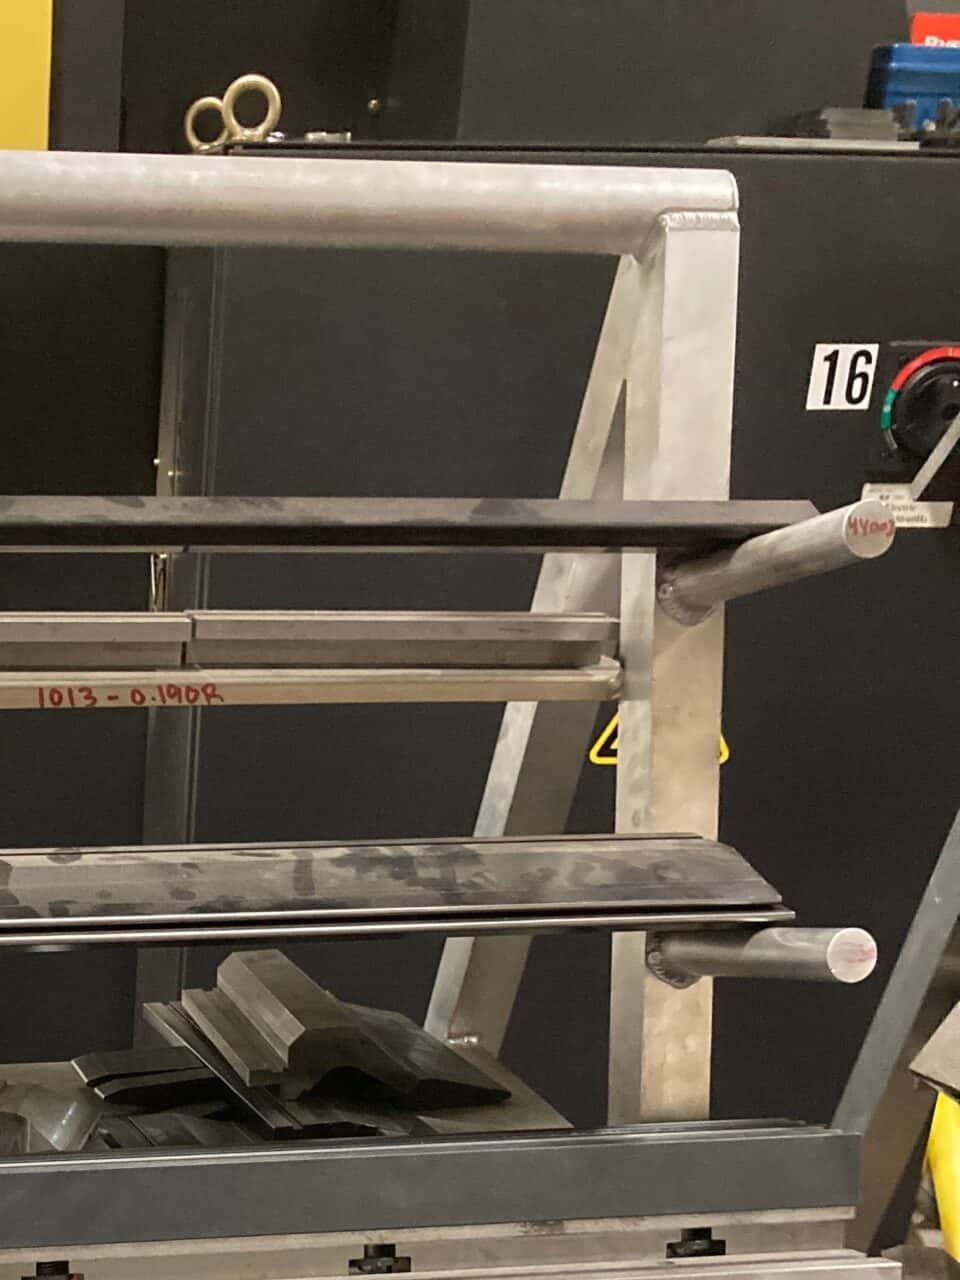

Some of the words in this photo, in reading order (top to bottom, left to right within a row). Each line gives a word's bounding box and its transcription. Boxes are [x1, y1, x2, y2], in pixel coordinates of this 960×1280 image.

[823, 348, 873, 406] 16
[38, 687, 98, 708] 1013
[130, 683, 225, 706] 0.190R
